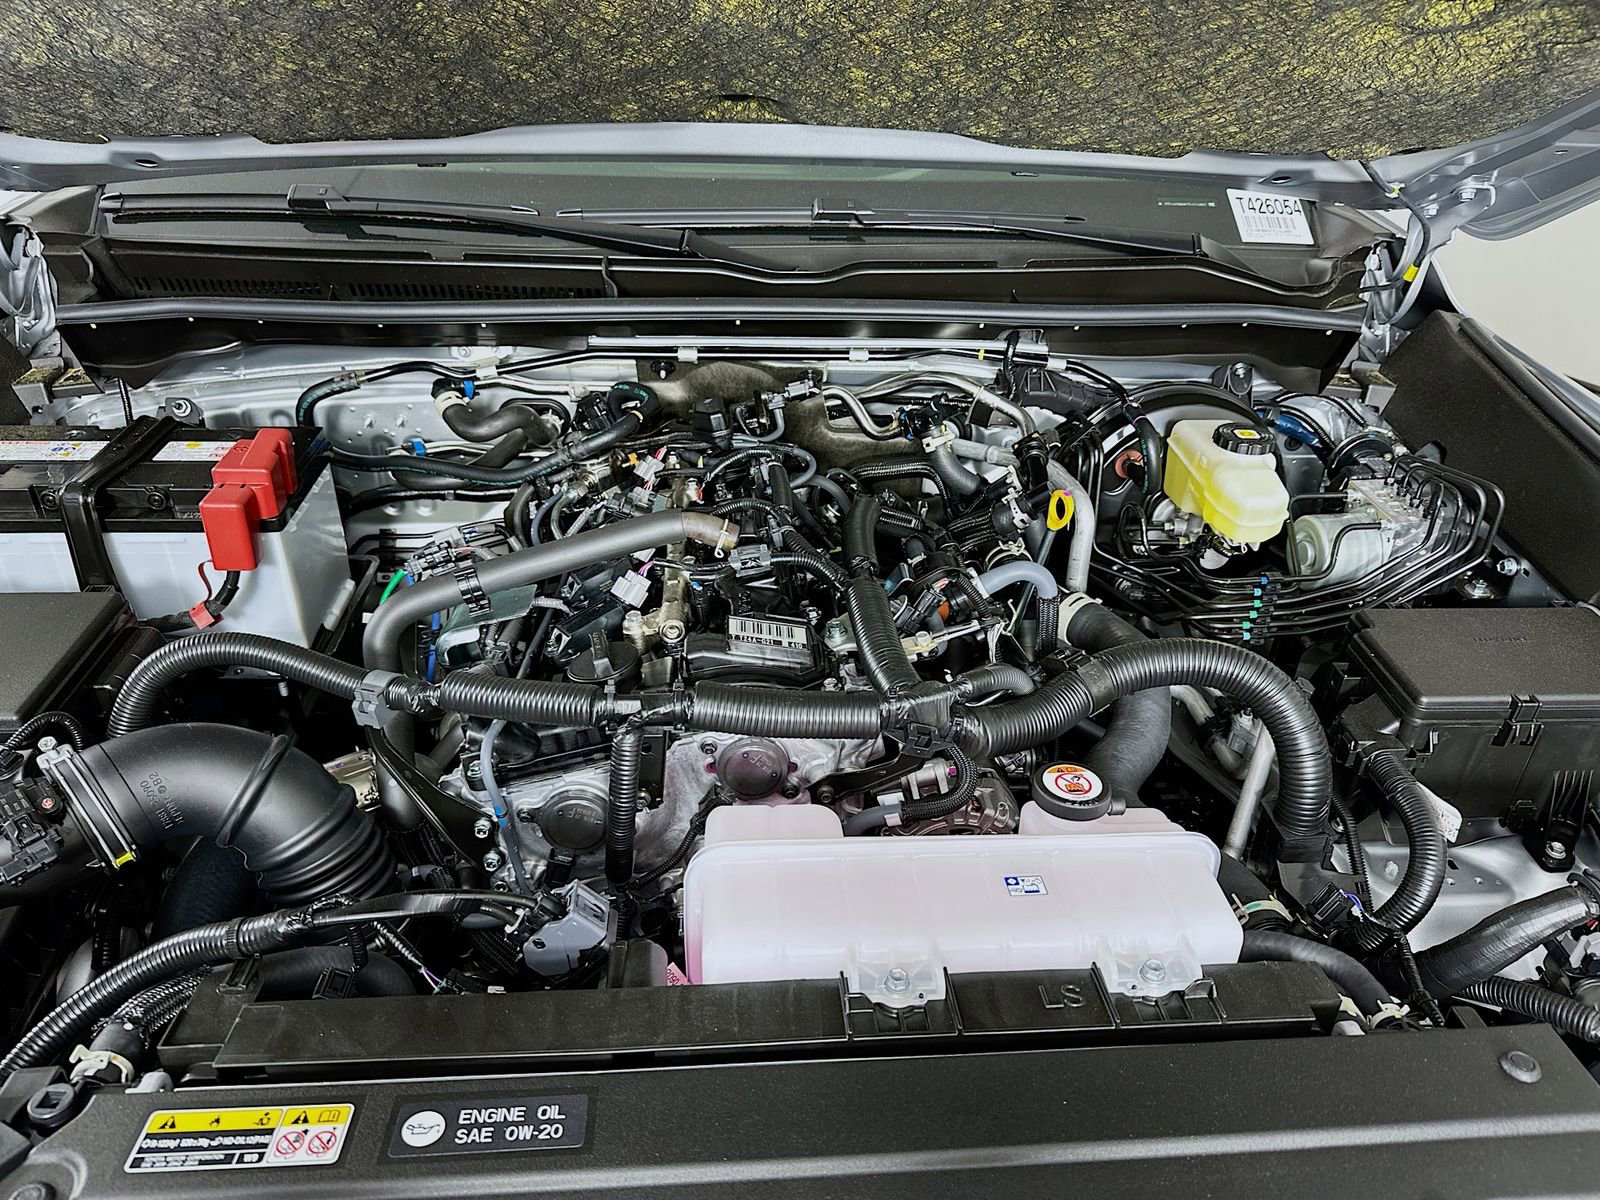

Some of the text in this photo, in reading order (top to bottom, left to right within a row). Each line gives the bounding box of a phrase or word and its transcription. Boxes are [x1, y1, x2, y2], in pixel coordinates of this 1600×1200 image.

[1235, 197, 1302, 216] T426054
[1038, 984, 1087, 1008] LS
[458, 1104, 566, 1125] ENGINE OIL
[454, 1123, 564, 1144] SAE 0W-20
